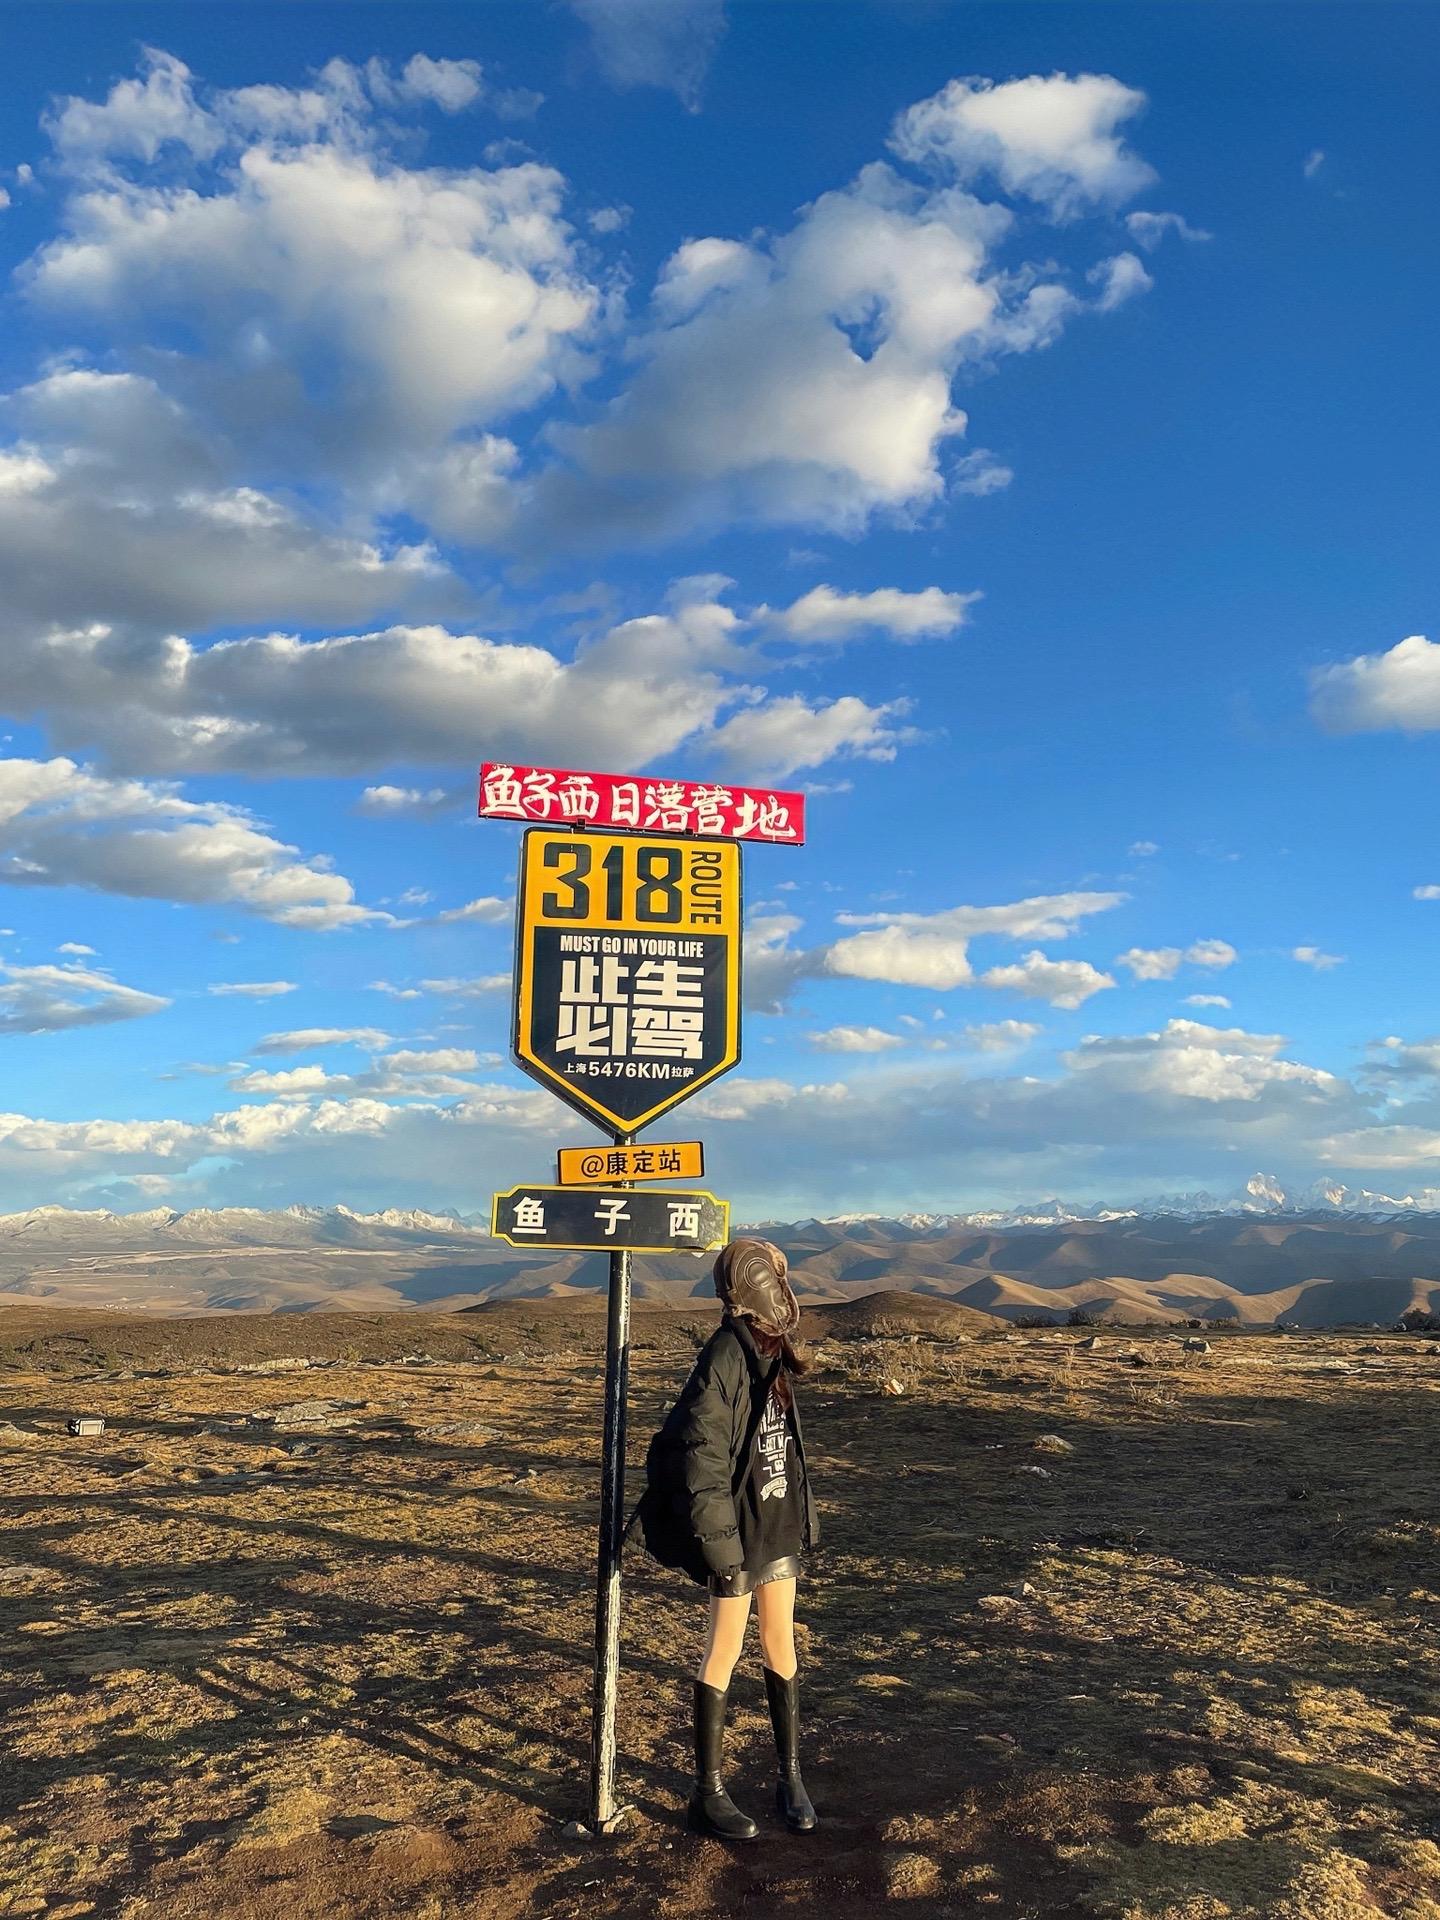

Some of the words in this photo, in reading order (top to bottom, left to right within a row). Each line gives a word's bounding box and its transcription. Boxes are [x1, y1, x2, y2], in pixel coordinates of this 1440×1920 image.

[542, 842, 682, 923] 318
[690, 850, 722, 925] ROUTE
[560, 935, 600, 953] MUST
[601, 937, 621, 954] GO
[623, 938, 637, 955] IN
[640, 939, 676, 957] YOUR
[678, 941, 704, 958] LIFE
[559, 956, 705, 1008] 此生
[555, 1005, 704, 1060] 必驾
[581, 1149, 681, 1178] @康定站
